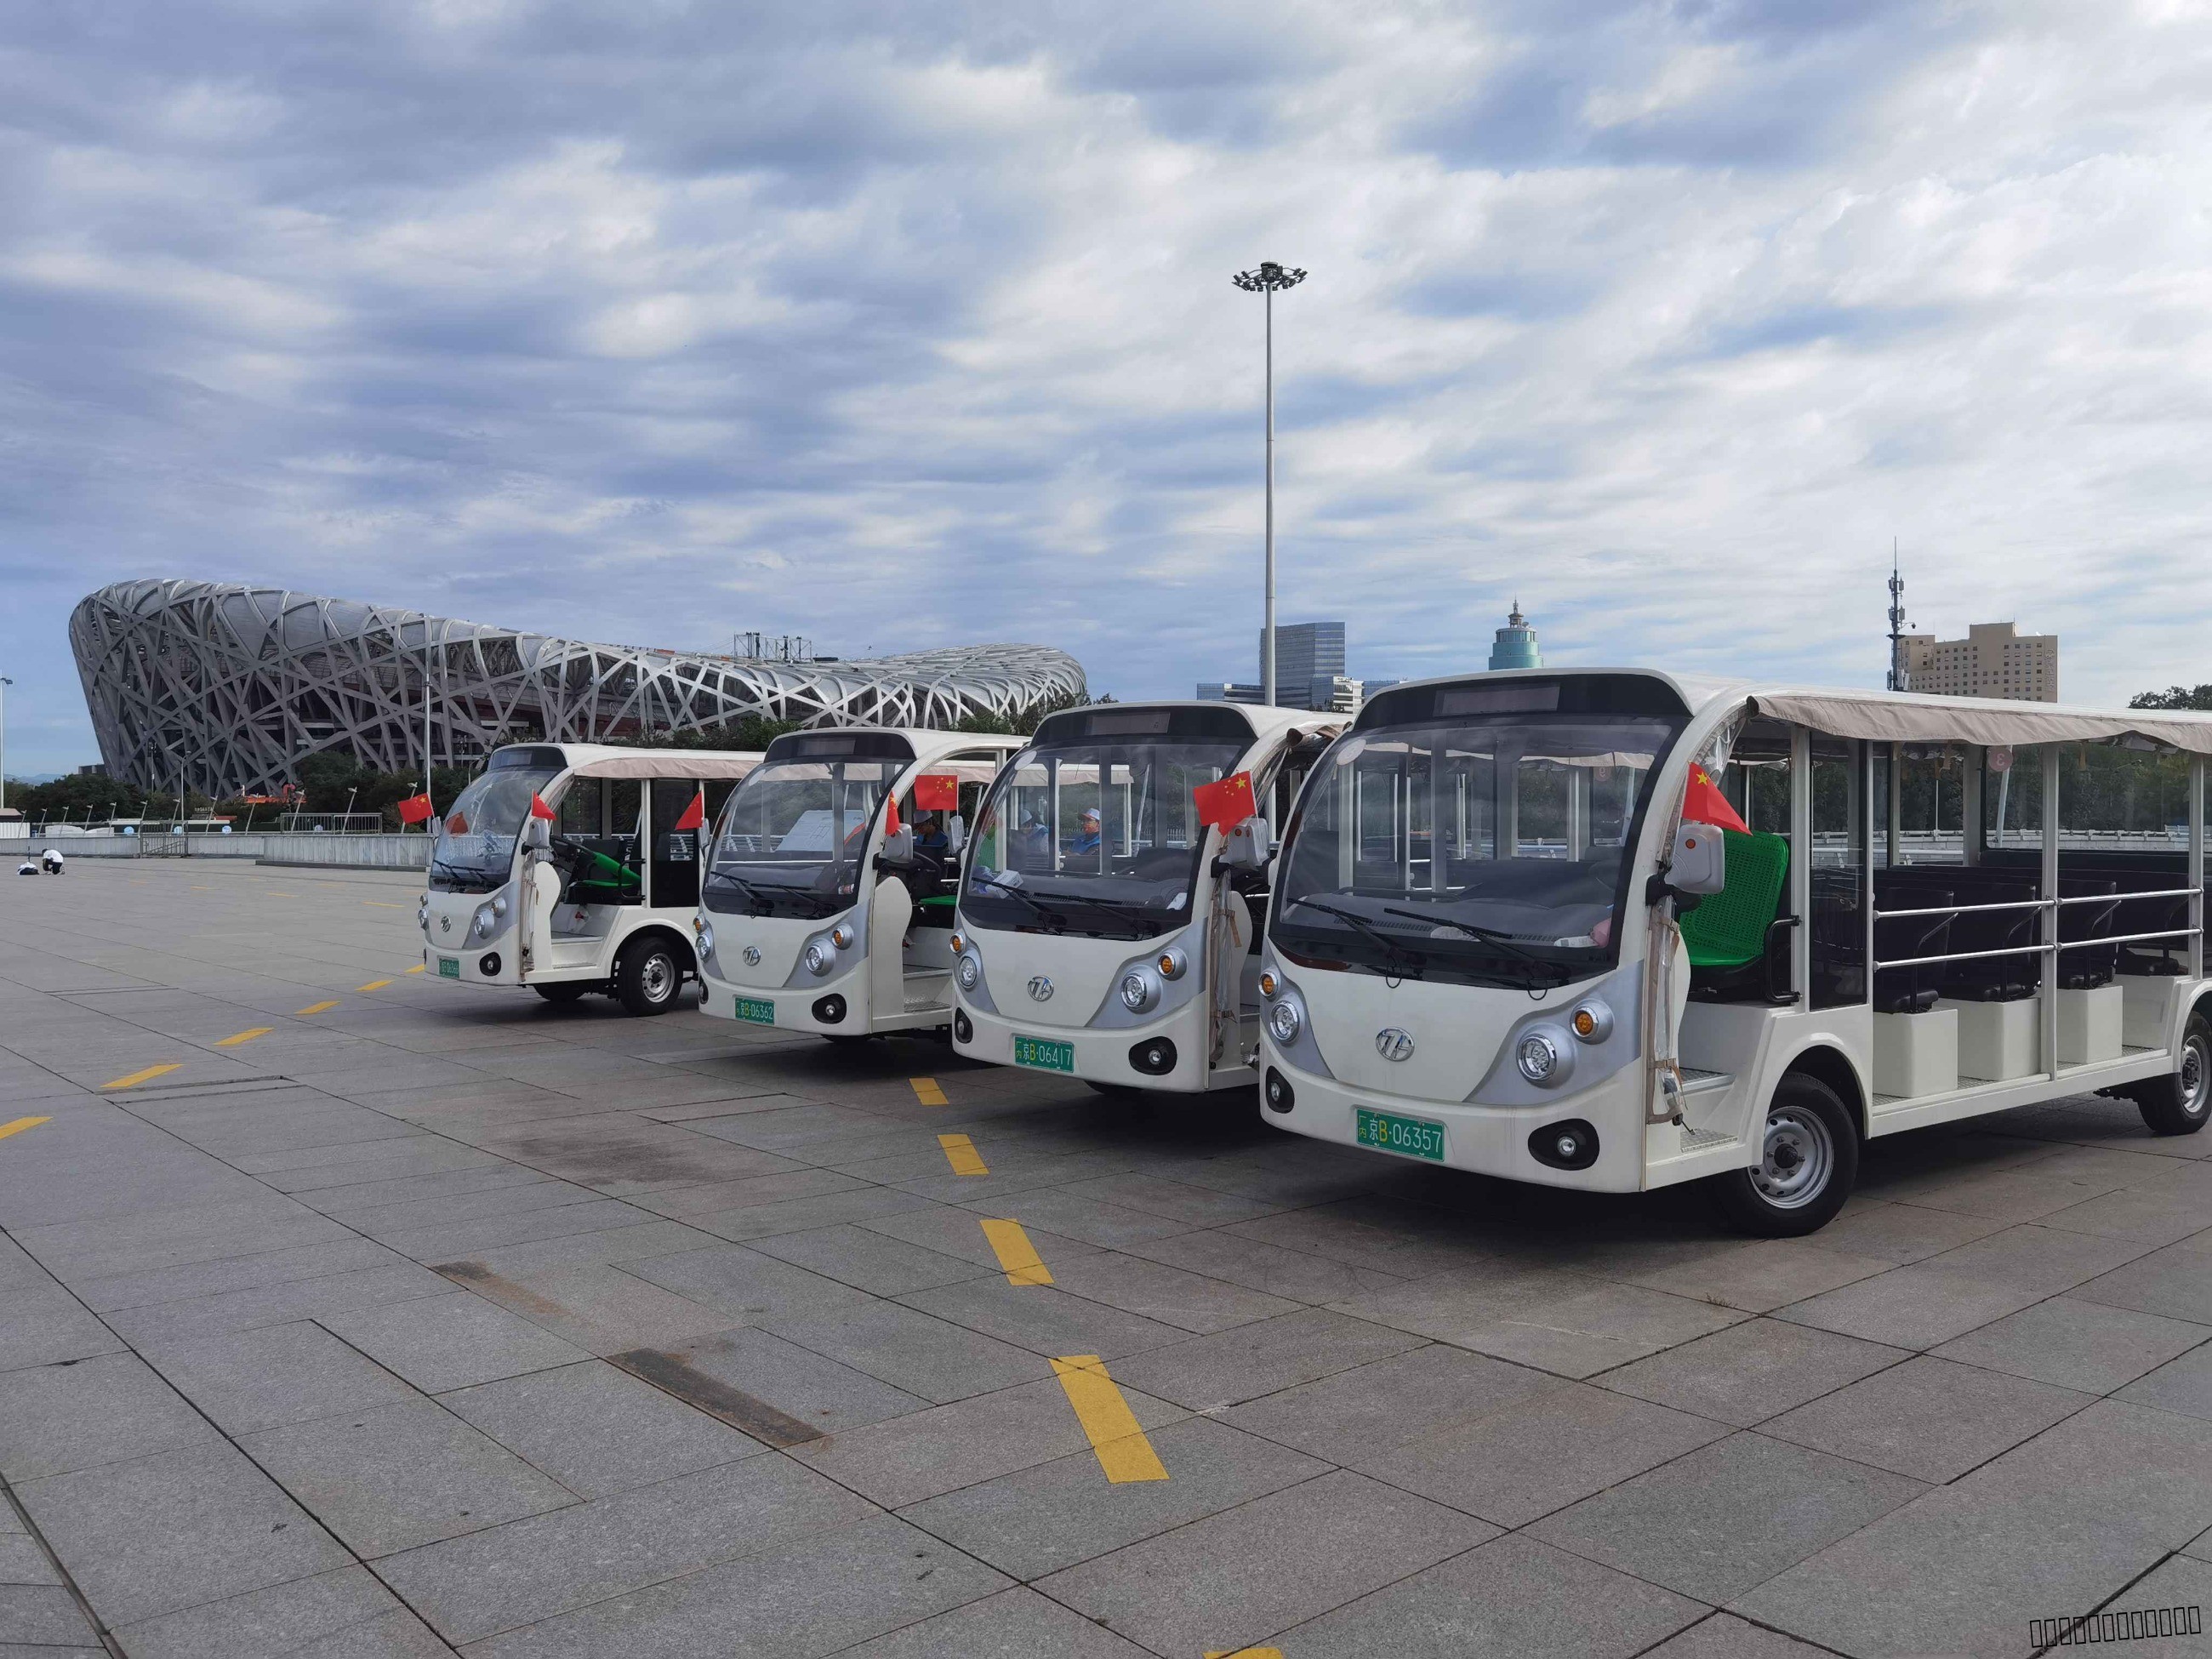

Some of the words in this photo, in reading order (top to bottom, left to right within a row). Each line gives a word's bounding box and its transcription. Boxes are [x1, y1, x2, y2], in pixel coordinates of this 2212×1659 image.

[739, 1001, 773, 1020] 京B·06362
[1023, 1042, 1072, 1066] 京B·06417
[1369, 1118, 1442, 1153] 京B·06357
